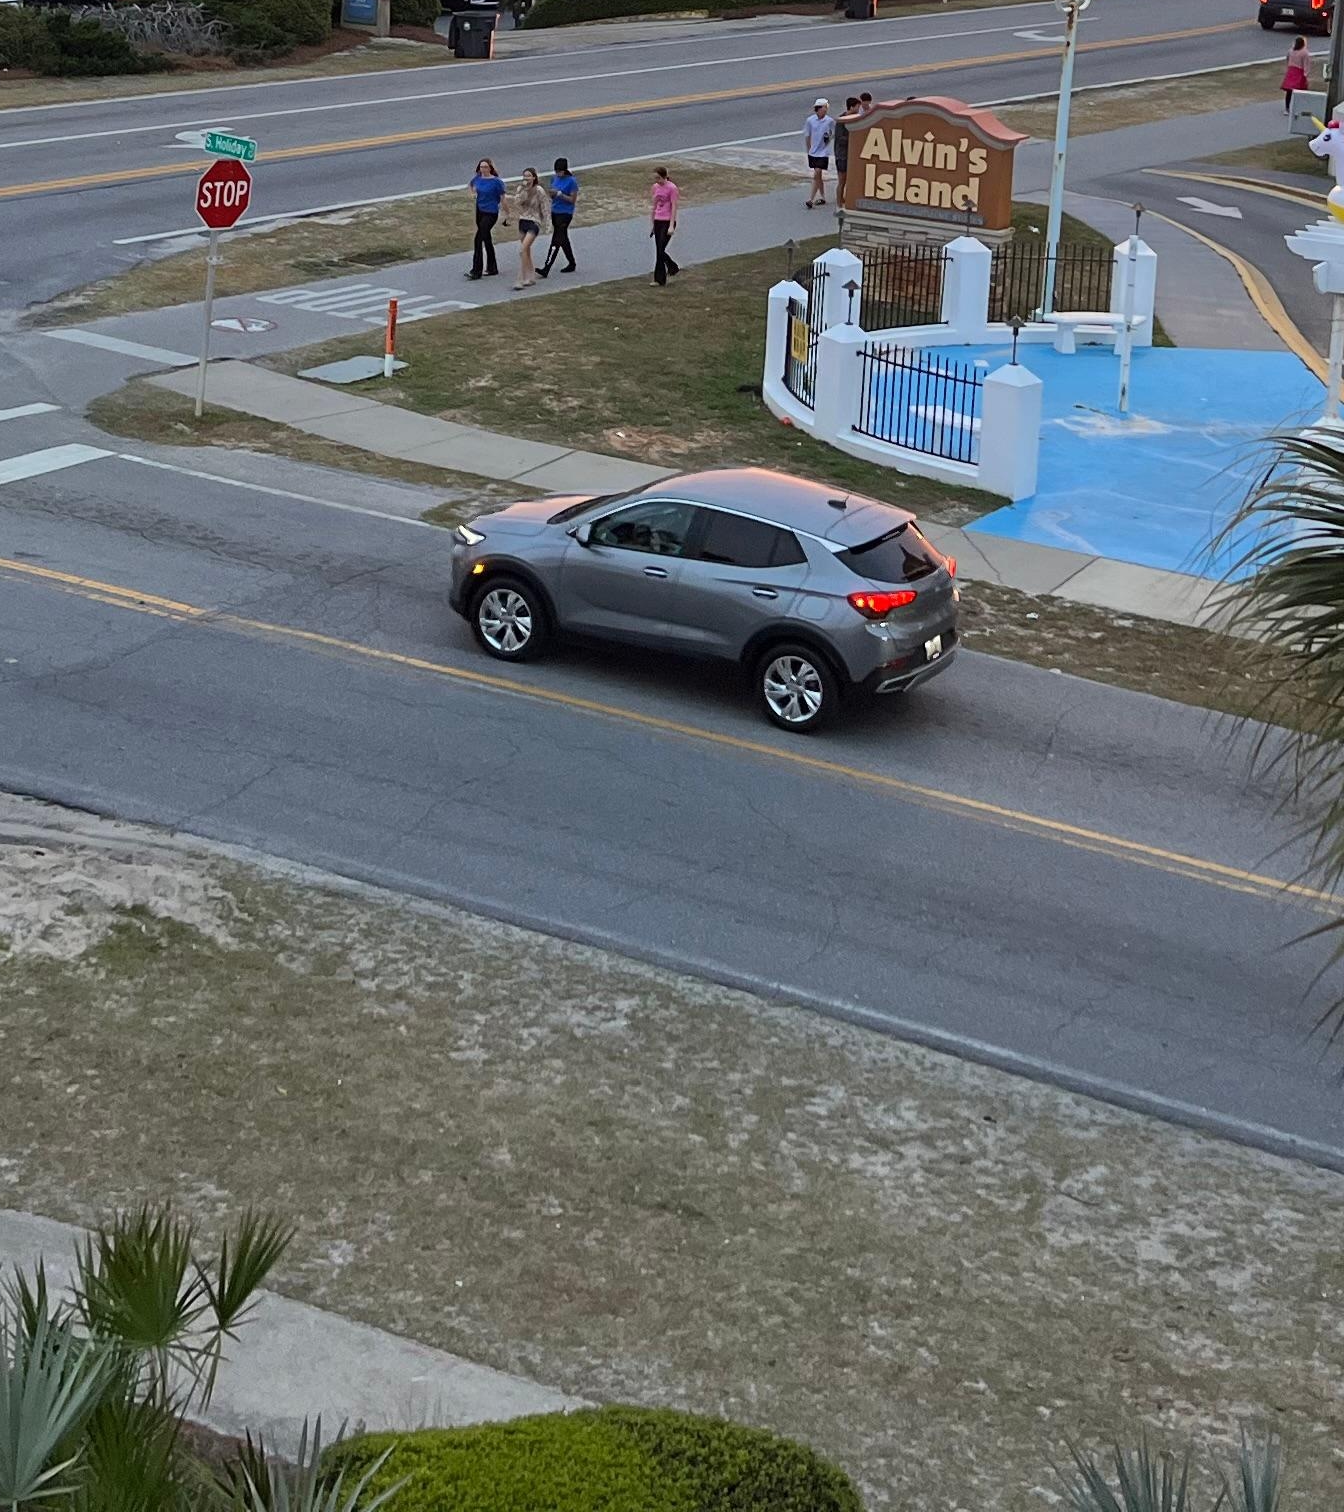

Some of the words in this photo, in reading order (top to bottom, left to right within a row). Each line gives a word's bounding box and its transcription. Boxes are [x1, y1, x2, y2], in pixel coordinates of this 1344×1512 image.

[215, 135, 248, 160] Holiday
[859, 127, 988, 175] Alvin's
[200, 180, 248, 208] STOP
[864, 163, 980, 212] Island
